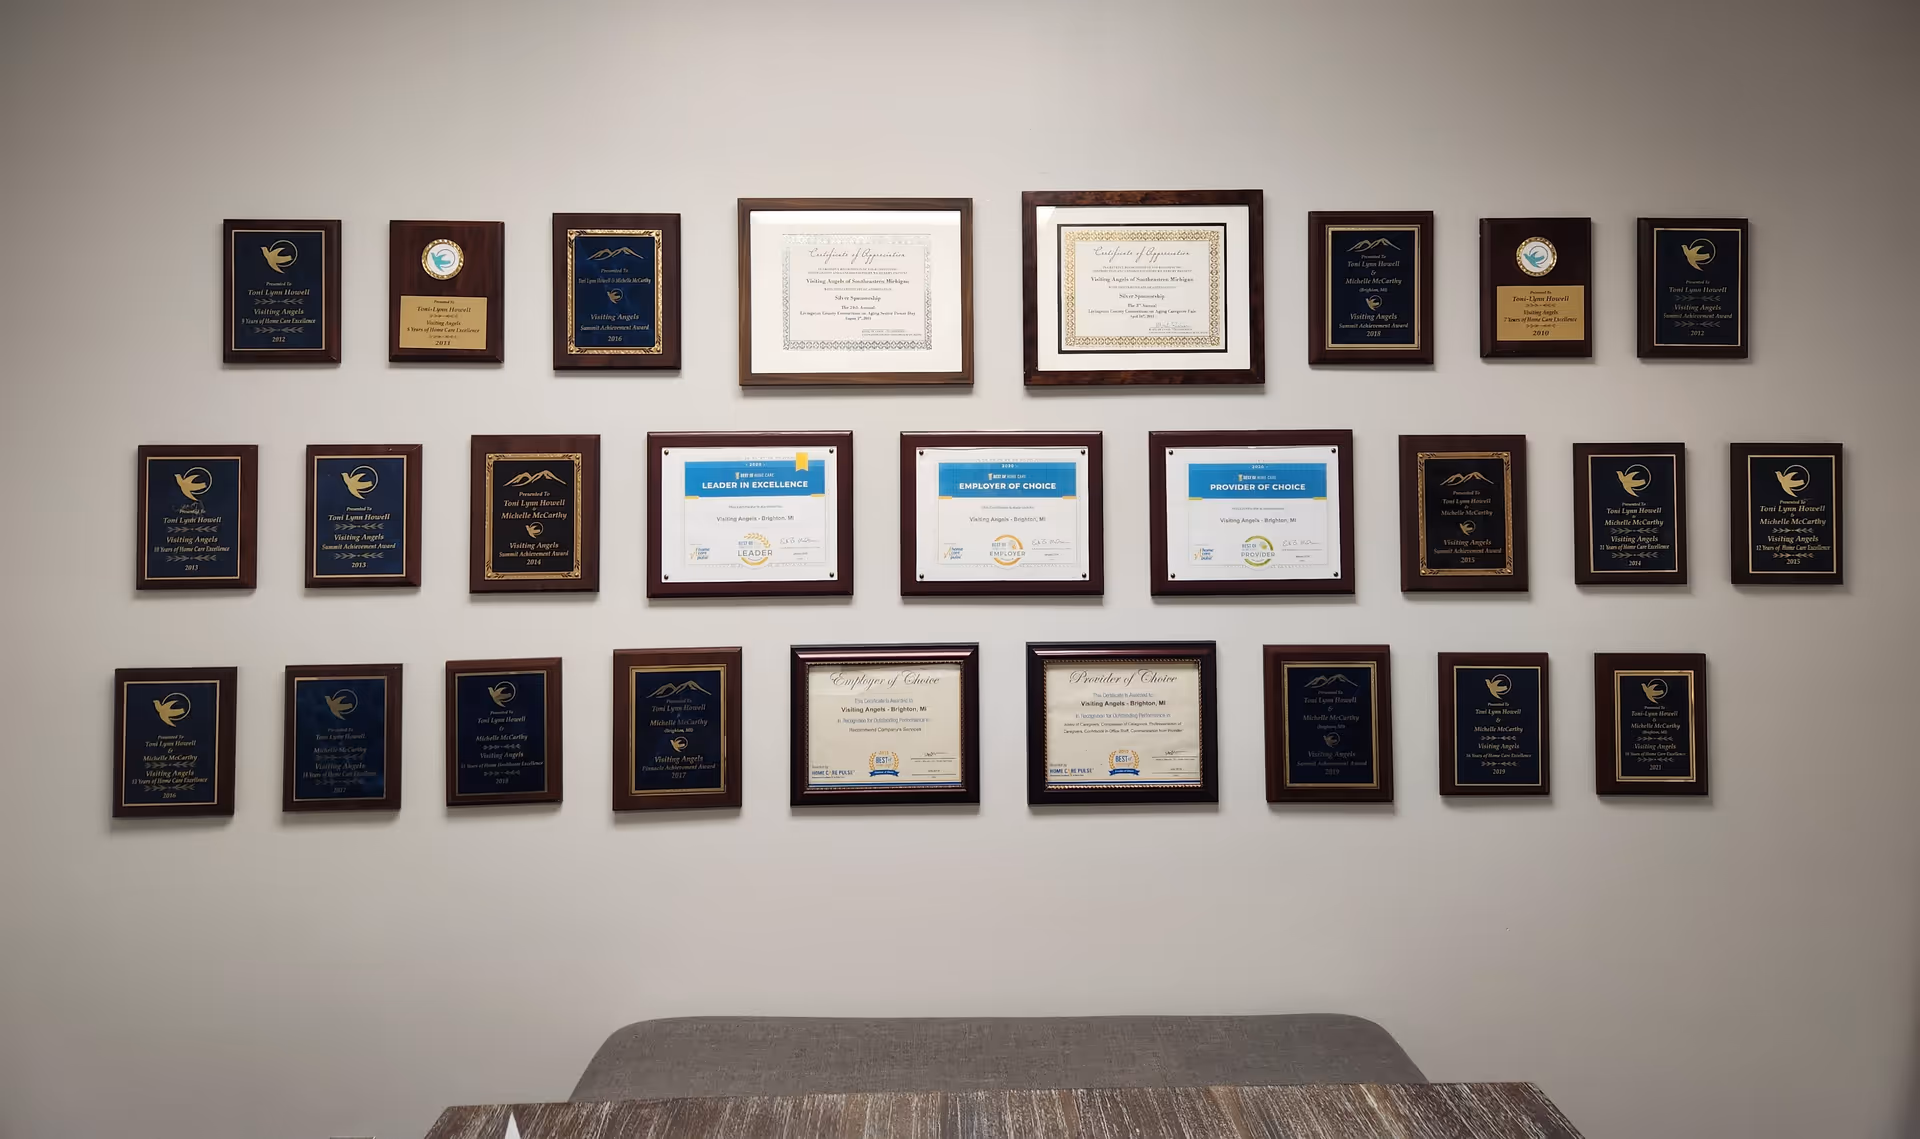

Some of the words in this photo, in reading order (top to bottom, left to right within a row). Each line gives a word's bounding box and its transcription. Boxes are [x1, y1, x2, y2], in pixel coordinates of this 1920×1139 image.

[265, 289, 282, 297] Lynn
[254, 308, 280, 316] Visiting
[617, 314, 639, 322] Angels
[1350, 313, 1374, 321] Visiting
[1376, 313, 1397, 321] Angels
[521, 500, 538, 508] Lynn
[346, 514, 363, 522] Lynn
[532, 512, 567, 520] McCarthy
[510, 542, 535, 550] Visiting
[536, 542, 559, 550] Angels
[1470, 539, 1491, 547] Angels
[830, 672, 885, 690] Employer
[888, 674, 900, 689] of
[902, 670, 940, 685] Choice
[1069, 670, 1121, 684] Provider
[1124, 672, 1136, 687] of
[1138, 669, 1177, 683] Choice
[654, 756, 680, 764] Visiting
